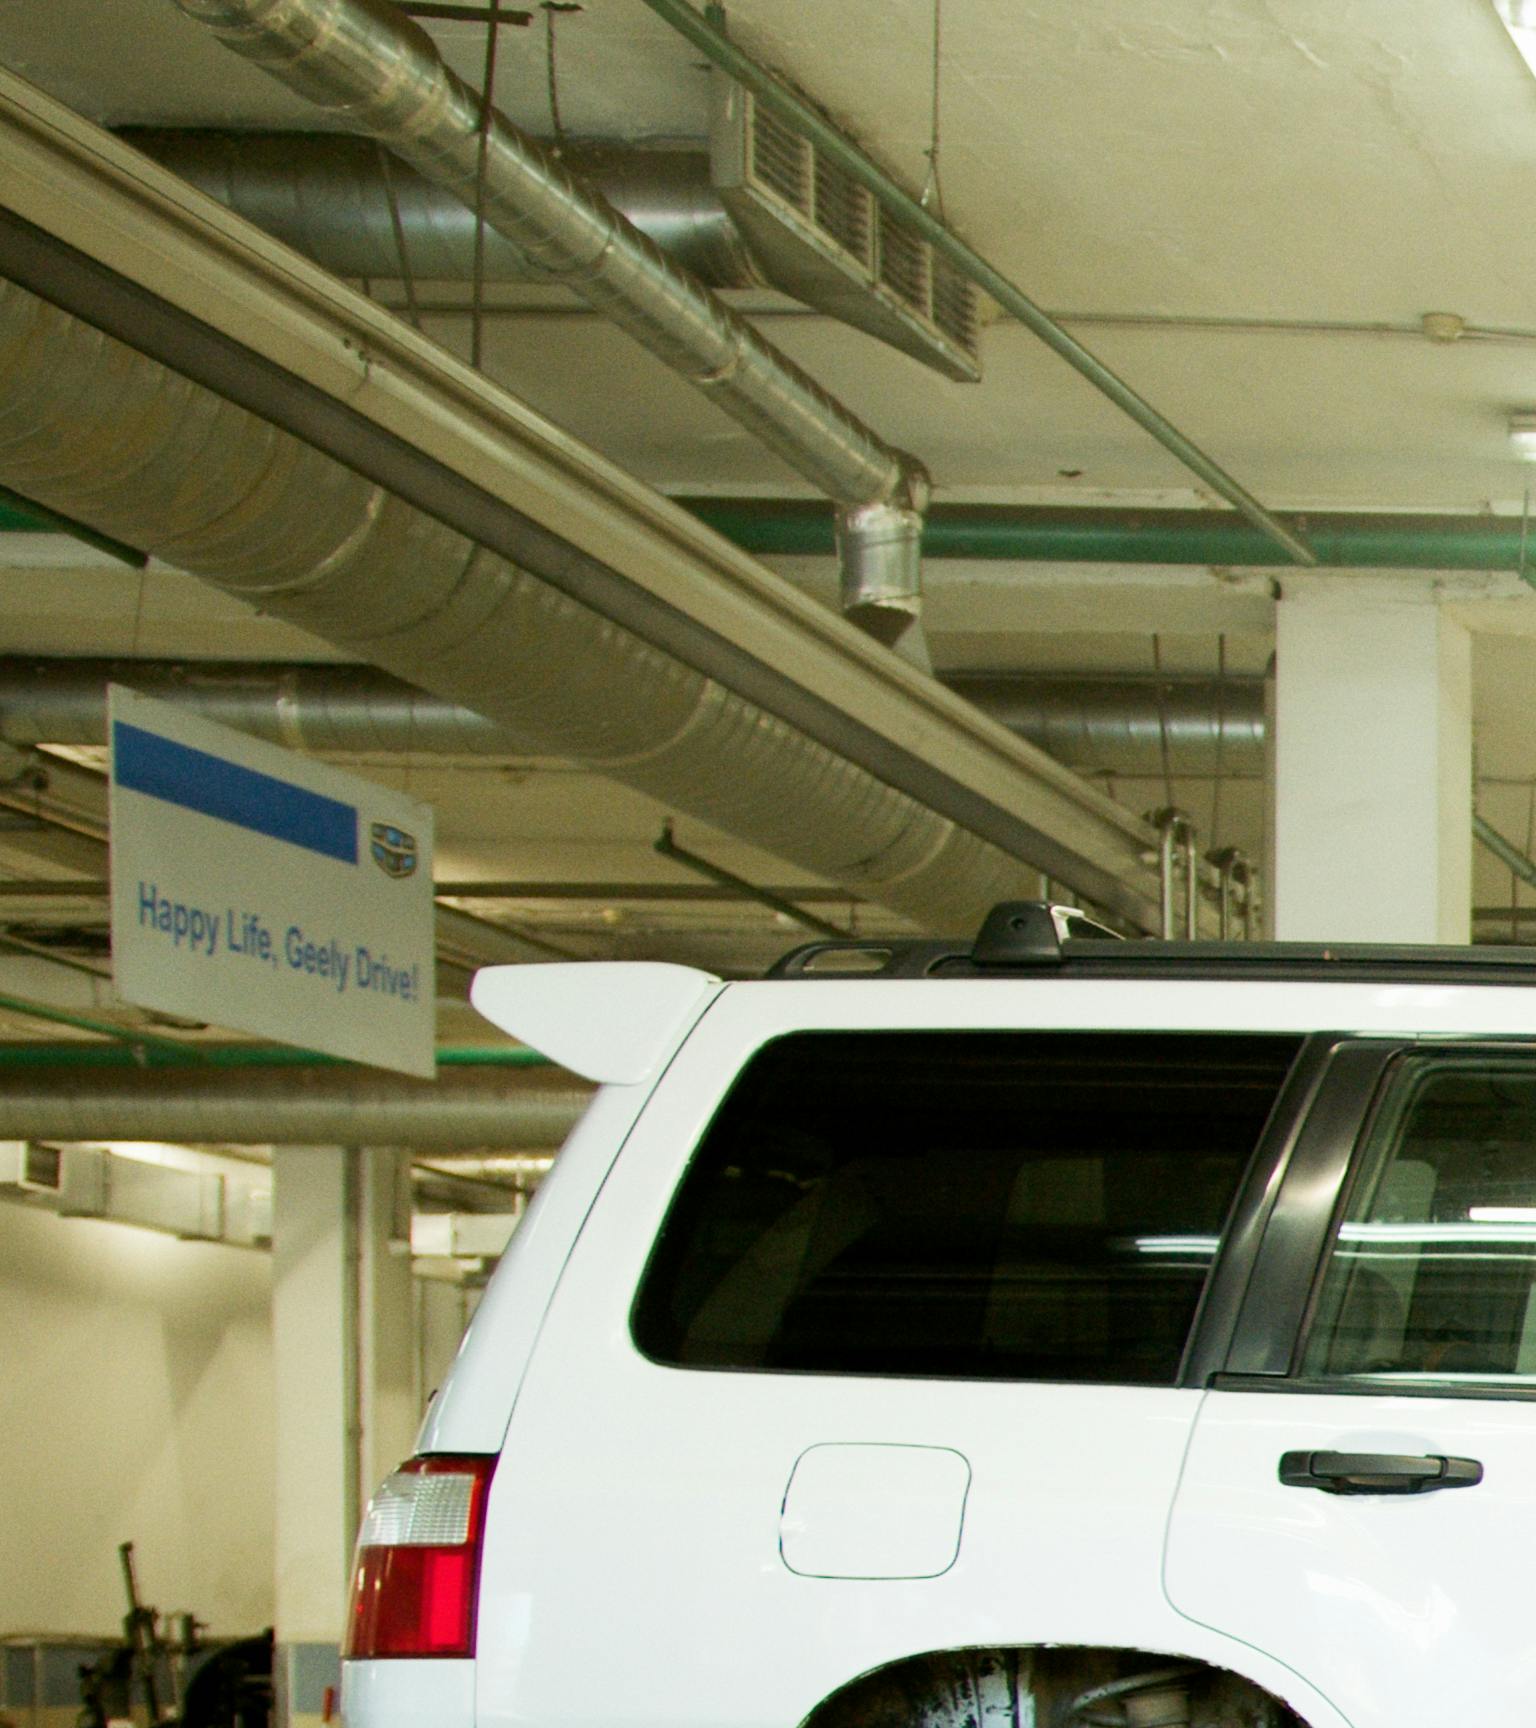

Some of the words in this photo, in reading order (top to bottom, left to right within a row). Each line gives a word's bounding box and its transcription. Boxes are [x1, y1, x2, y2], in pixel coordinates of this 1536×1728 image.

[139, 880, 219, 956] Happy
[227, 909, 276, 968] Life,
[285, 926, 347, 992] Geely
[355, 945, 418, 1001] Drive!
